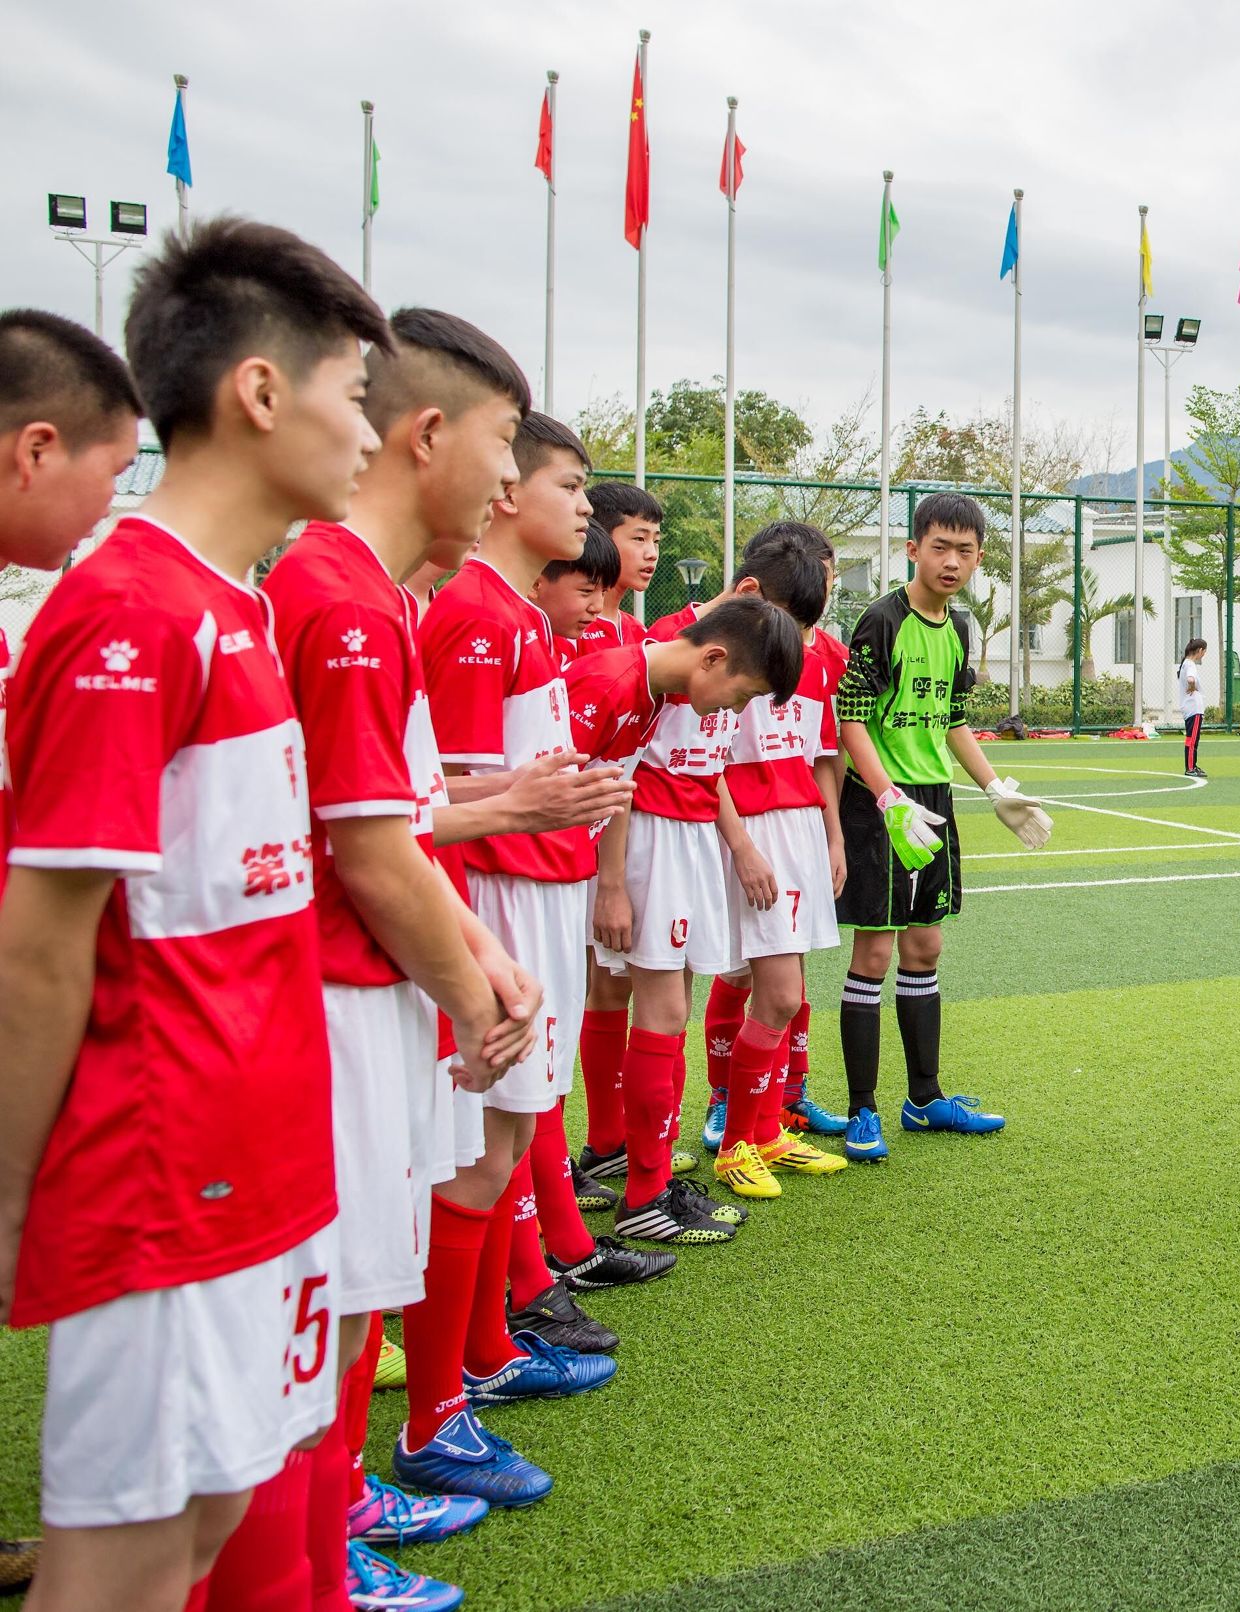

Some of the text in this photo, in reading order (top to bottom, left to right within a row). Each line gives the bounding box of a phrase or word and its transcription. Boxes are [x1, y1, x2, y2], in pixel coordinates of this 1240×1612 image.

[326, 655, 381, 669] KELME
[459, 656, 502, 666] KELME
[75, 674, 158, 693] KELME
[913, 676, 949, 701] 呼市
[569, 709, 596, 730] KELME
[909, 870, 919, 911] 1
[786, 890, 801, 933] 7
[545, 1016, 557, 1083] 5
